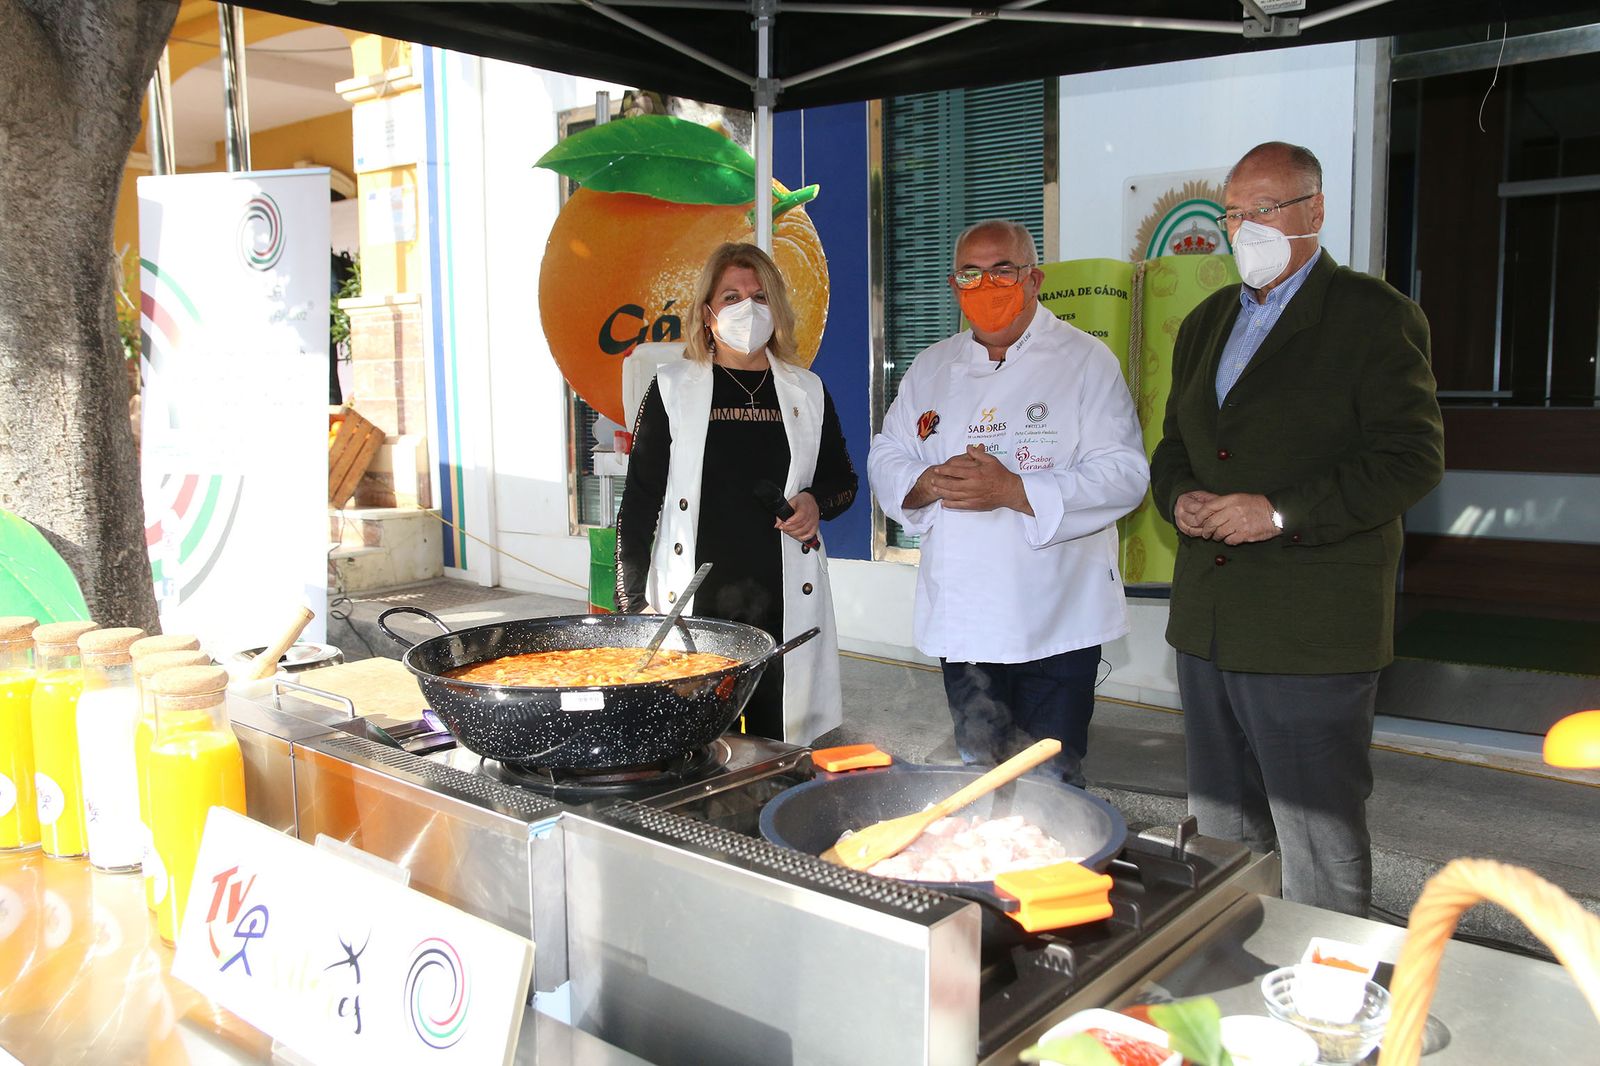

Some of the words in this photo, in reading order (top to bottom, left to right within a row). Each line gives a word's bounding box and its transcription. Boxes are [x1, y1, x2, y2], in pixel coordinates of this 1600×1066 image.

[1037, 288, 1075, 301] ARANJA
[1077, 286, 1092, 296] DE
[1094, 284, 1128, 300] GÁDOR
[1056, 312, 1076, 320] NTES
[968, 422, 1007, 433] SABORES
[984, 442, 999, 452] aén
